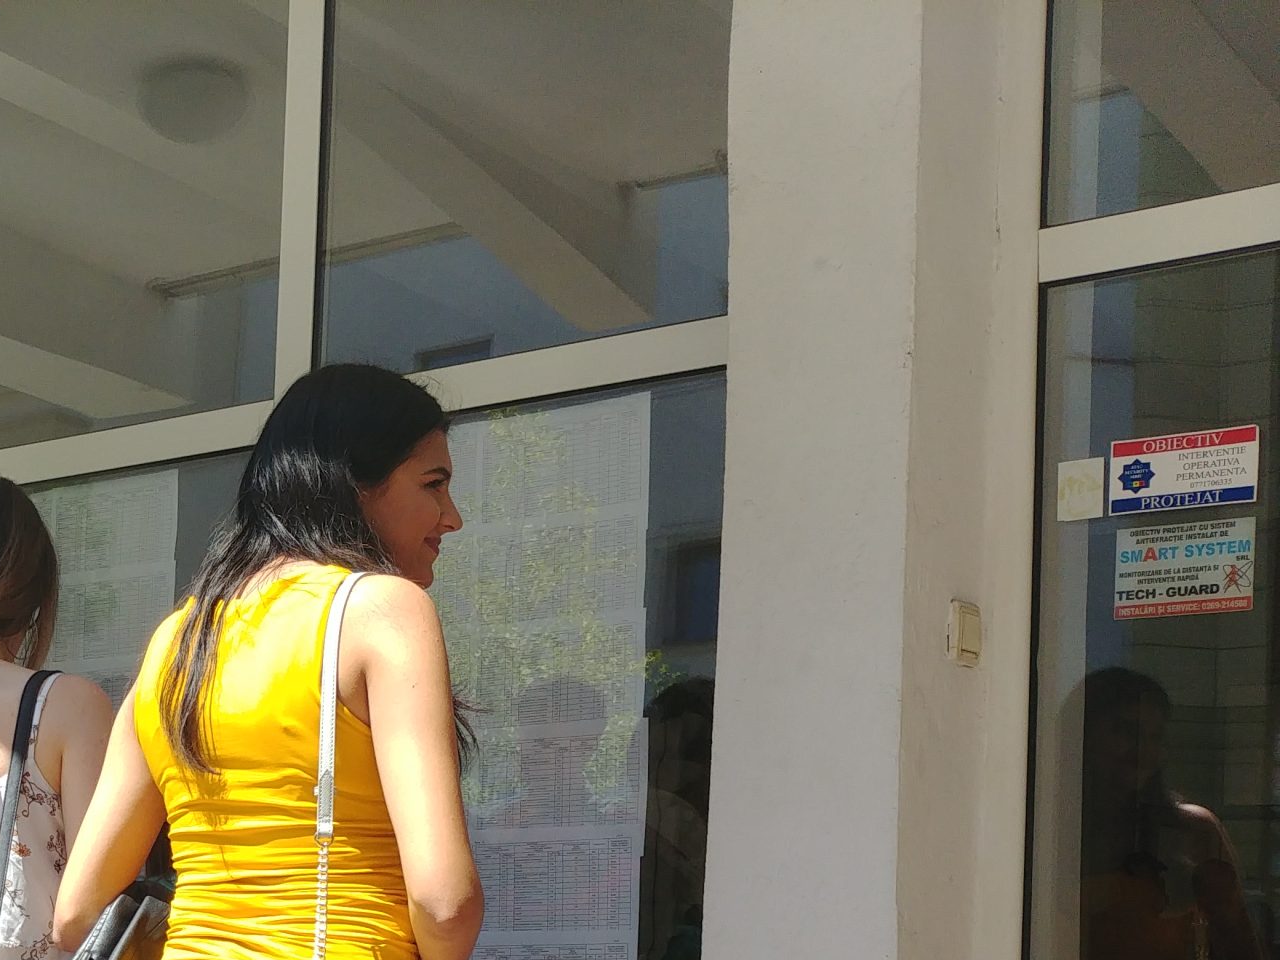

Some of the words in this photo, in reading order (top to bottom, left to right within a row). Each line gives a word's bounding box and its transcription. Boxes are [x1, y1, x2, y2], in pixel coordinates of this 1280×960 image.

[1143, 432, 1224, 453] OBIECTIV
[1178, 446, 1247, 461] INTERVENTIE
[1183, 457, 1240, 471] OPERATIVA
[1176, 467, 1247, 481] PERMANENTA
[1140, 490, 1224, 510] PROTEJAT
[1130, 529, 1160, 537] OBIECTIV
[1162, 526, 1197, 534] PROTEJAT
[1210, 521, 1236, 529] SISTEM
[1186, 531, 1217, 540] INSTALAT
[1120, 546, 1179, 564] SMART
[1184, 539, 1251, 558] SYSTEM
[1119, 569, 1162, 579] MONITORIZARE
[1116, 589, 1156, 601] TECH
[1166, 583, 1219, 598] GUARD
